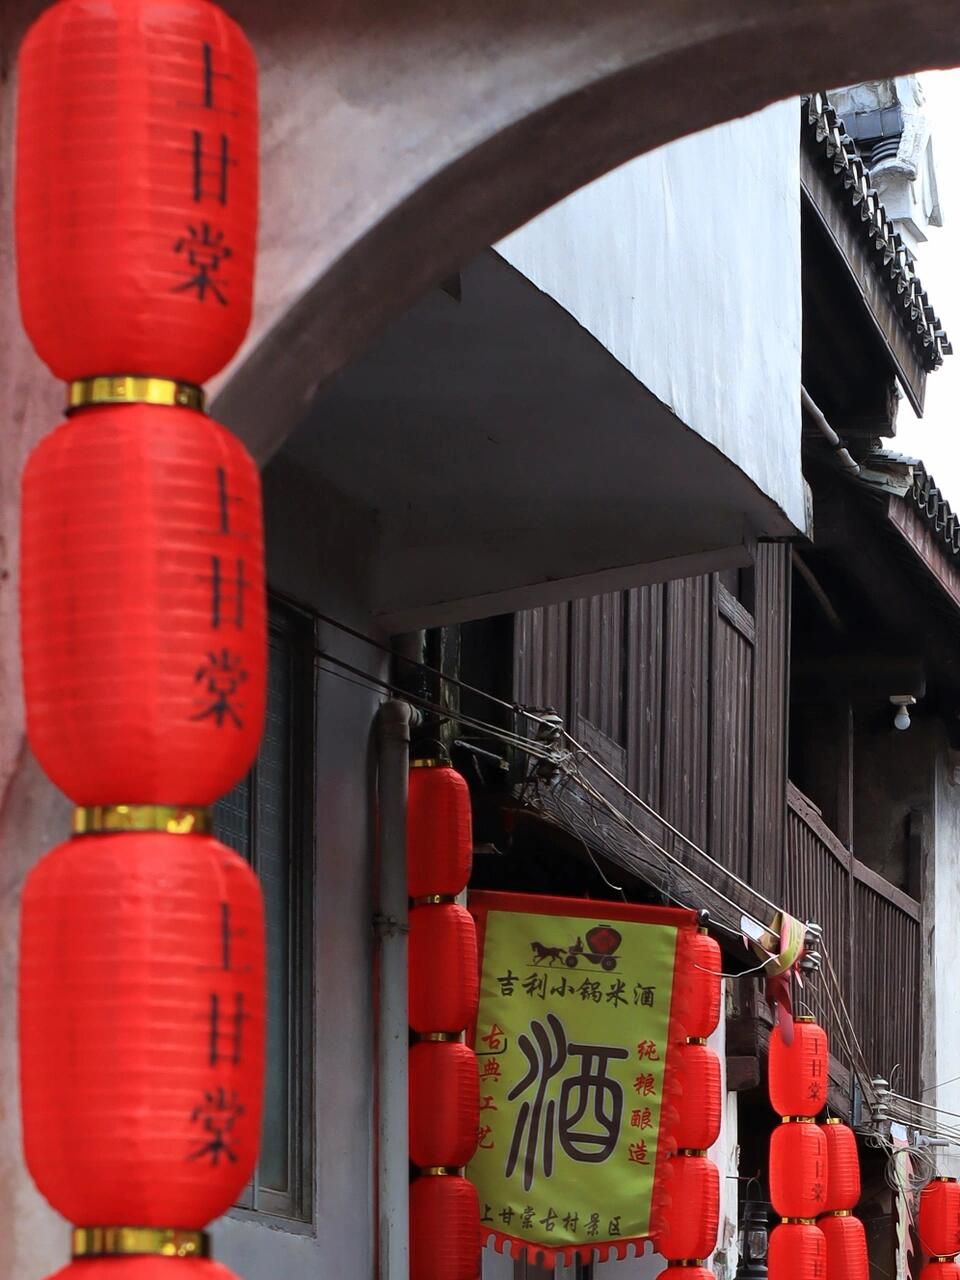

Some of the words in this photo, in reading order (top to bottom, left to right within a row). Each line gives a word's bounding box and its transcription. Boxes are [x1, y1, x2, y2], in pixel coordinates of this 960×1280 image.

[172, 42, 238, 306] 上甘棠
[191, 466, 251, 729] 上甘棠
[187, 902, 253, 1169] 上甘棠
[497, 970, 656, 1008] 吉利小锅米酒
[476, 1023, 505, 1150] 古典工艺
[628, 1040, 660, 1165] 纯粮酿造
[480, 1204, 622, 1237] 上甘棠古村景区
